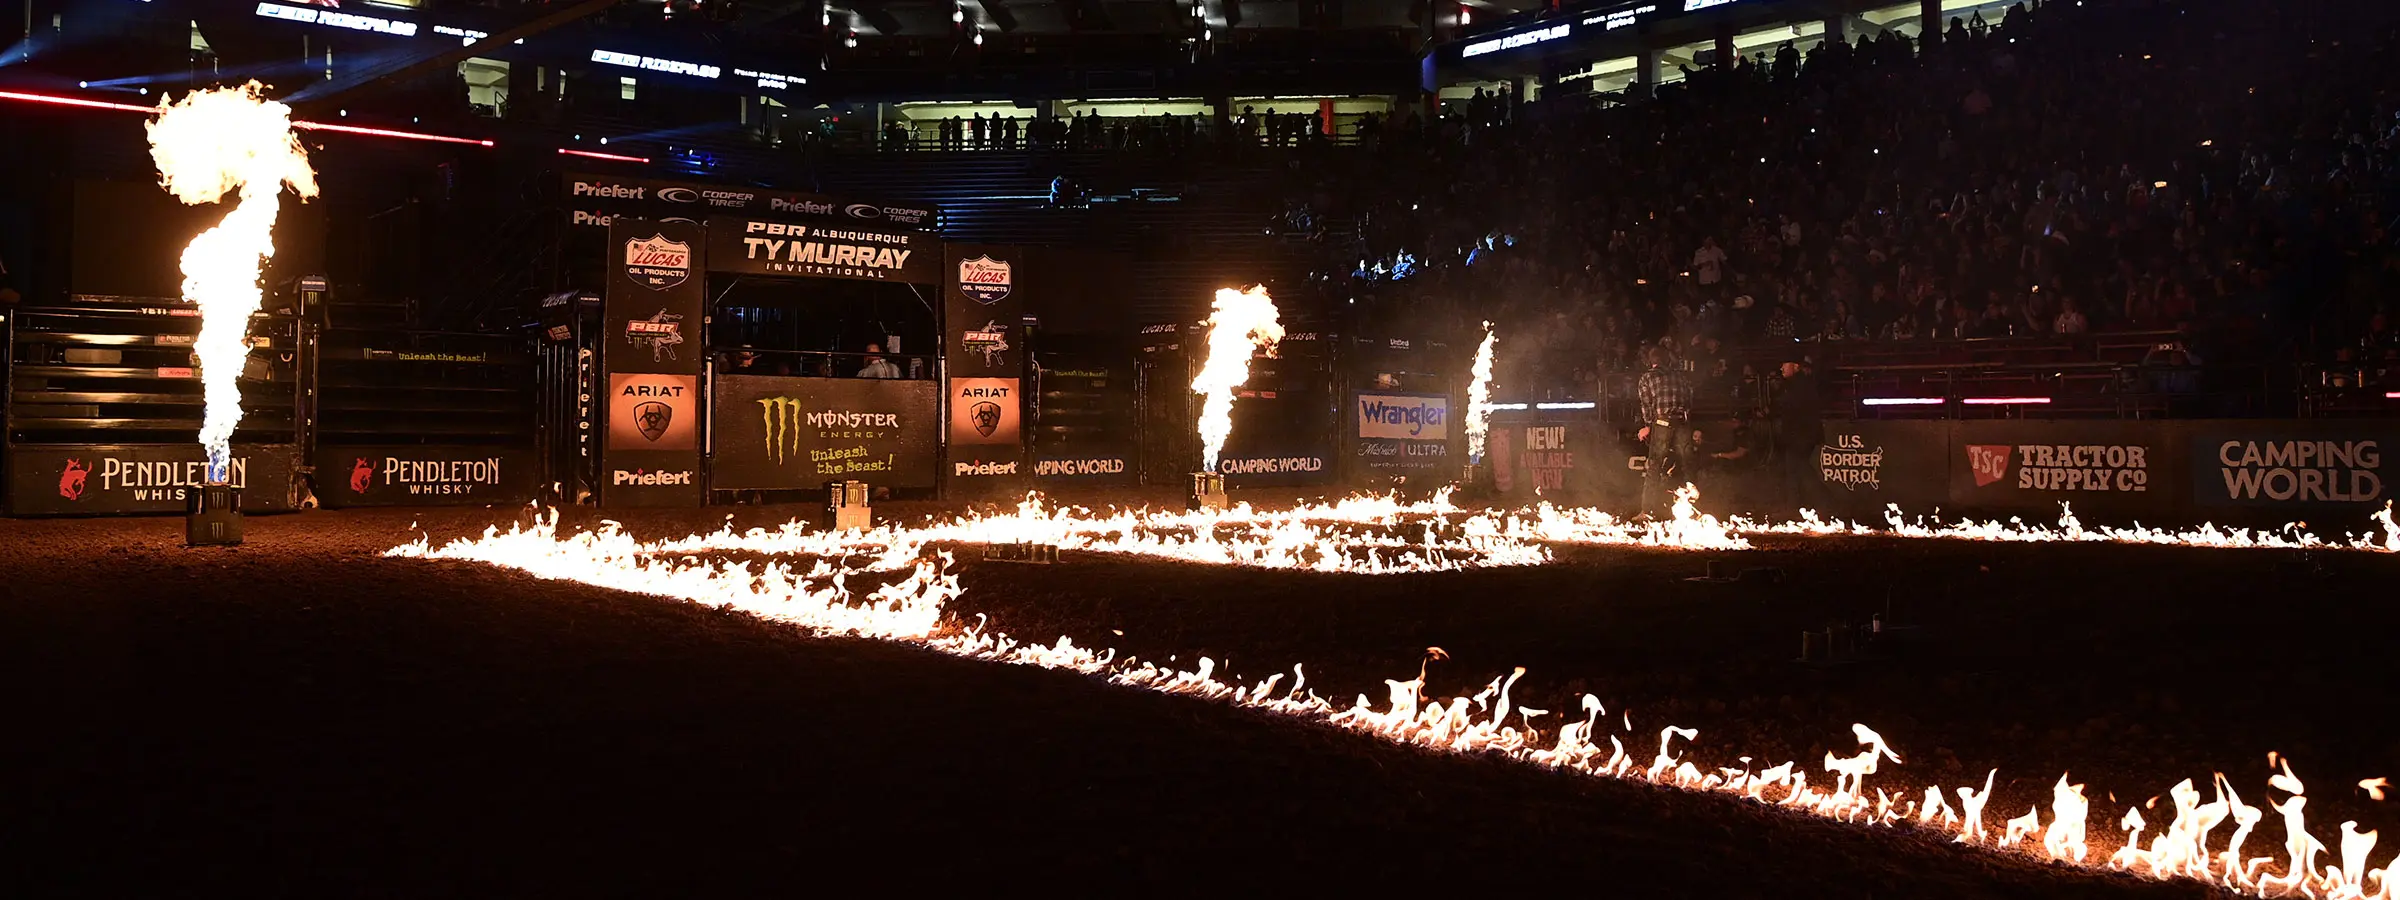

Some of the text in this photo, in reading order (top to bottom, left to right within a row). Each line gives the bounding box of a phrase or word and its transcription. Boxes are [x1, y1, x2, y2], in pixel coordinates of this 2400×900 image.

[573, 181, 645, 200] Priefert
[702, 190, 754, 201] COOPER
[708, 199, 746, 208] TIRES
[771, 197, 833, 215] Priefert
[883, 206, 928, 217] COOPER
[889, 214, 921, 224] TIRES
[746, 221, 909, 244] PBR ALBUQUERQUE
[633, 252, 684, 266] LUCAS
[743, 237, 911, 270] TY MURRAY
[628, 267, 685, 277] OIL PRODUCTS
[765, 263, 885, 278] INVITATIONAL
[966, 271, 1006, 283] LUCAS
[649, 277, 665, 285] INC.
[630, 321, 676, 333] PBR
[398, 352, 436, 361] Unleash
[437, 353, 454, 361] the
[455, 351, 487, 362] Beast!
[622, 385, 684, 397] ARIAT
[961, 388, 1009, 398] ARIAT
[579, 348, 592, 456] Priefert
[806, 409, 899, 429] MONSTER
[1361, 400, 1444, 435] Wrangler
[1526, 426, 1565, 450] NEW!
[1838, 434, 1864, 448] U.S.
[810, 445, 869, 462] Unleash
[1407, 444, 1447, 456] ULTRA
[2018, 445, 2147, 468] TRACTOR
[2219, 440, 2380, 468] CAMPING
[816, 453, 894, 475] the Beast!
[955, 459, 1017, 477] Priefert
[1033, 458, 1124, 476] MPING WORLD
[1221, 457, 1322, 474] CAMPING WORLD
[1519, 452, 1574, 468] AVAILABLE
[1822, 453, 1881, 467] BORDER
[1970, 446, 2004, 479] TSC
[383, 457, 500, 485] PENDLETON
[613, 468, 692, 486] Priefert
[1531, 468, 1563, 490] NOW
[1823, 468, 1880, 483] PATROL
[2018, 468, 2112, 491] SUPPLY
[409, 484, 473, 495] WHISKY
[2222, 467, 2382, 502] WORLD
[134, 489, 187, 501] WHIS
